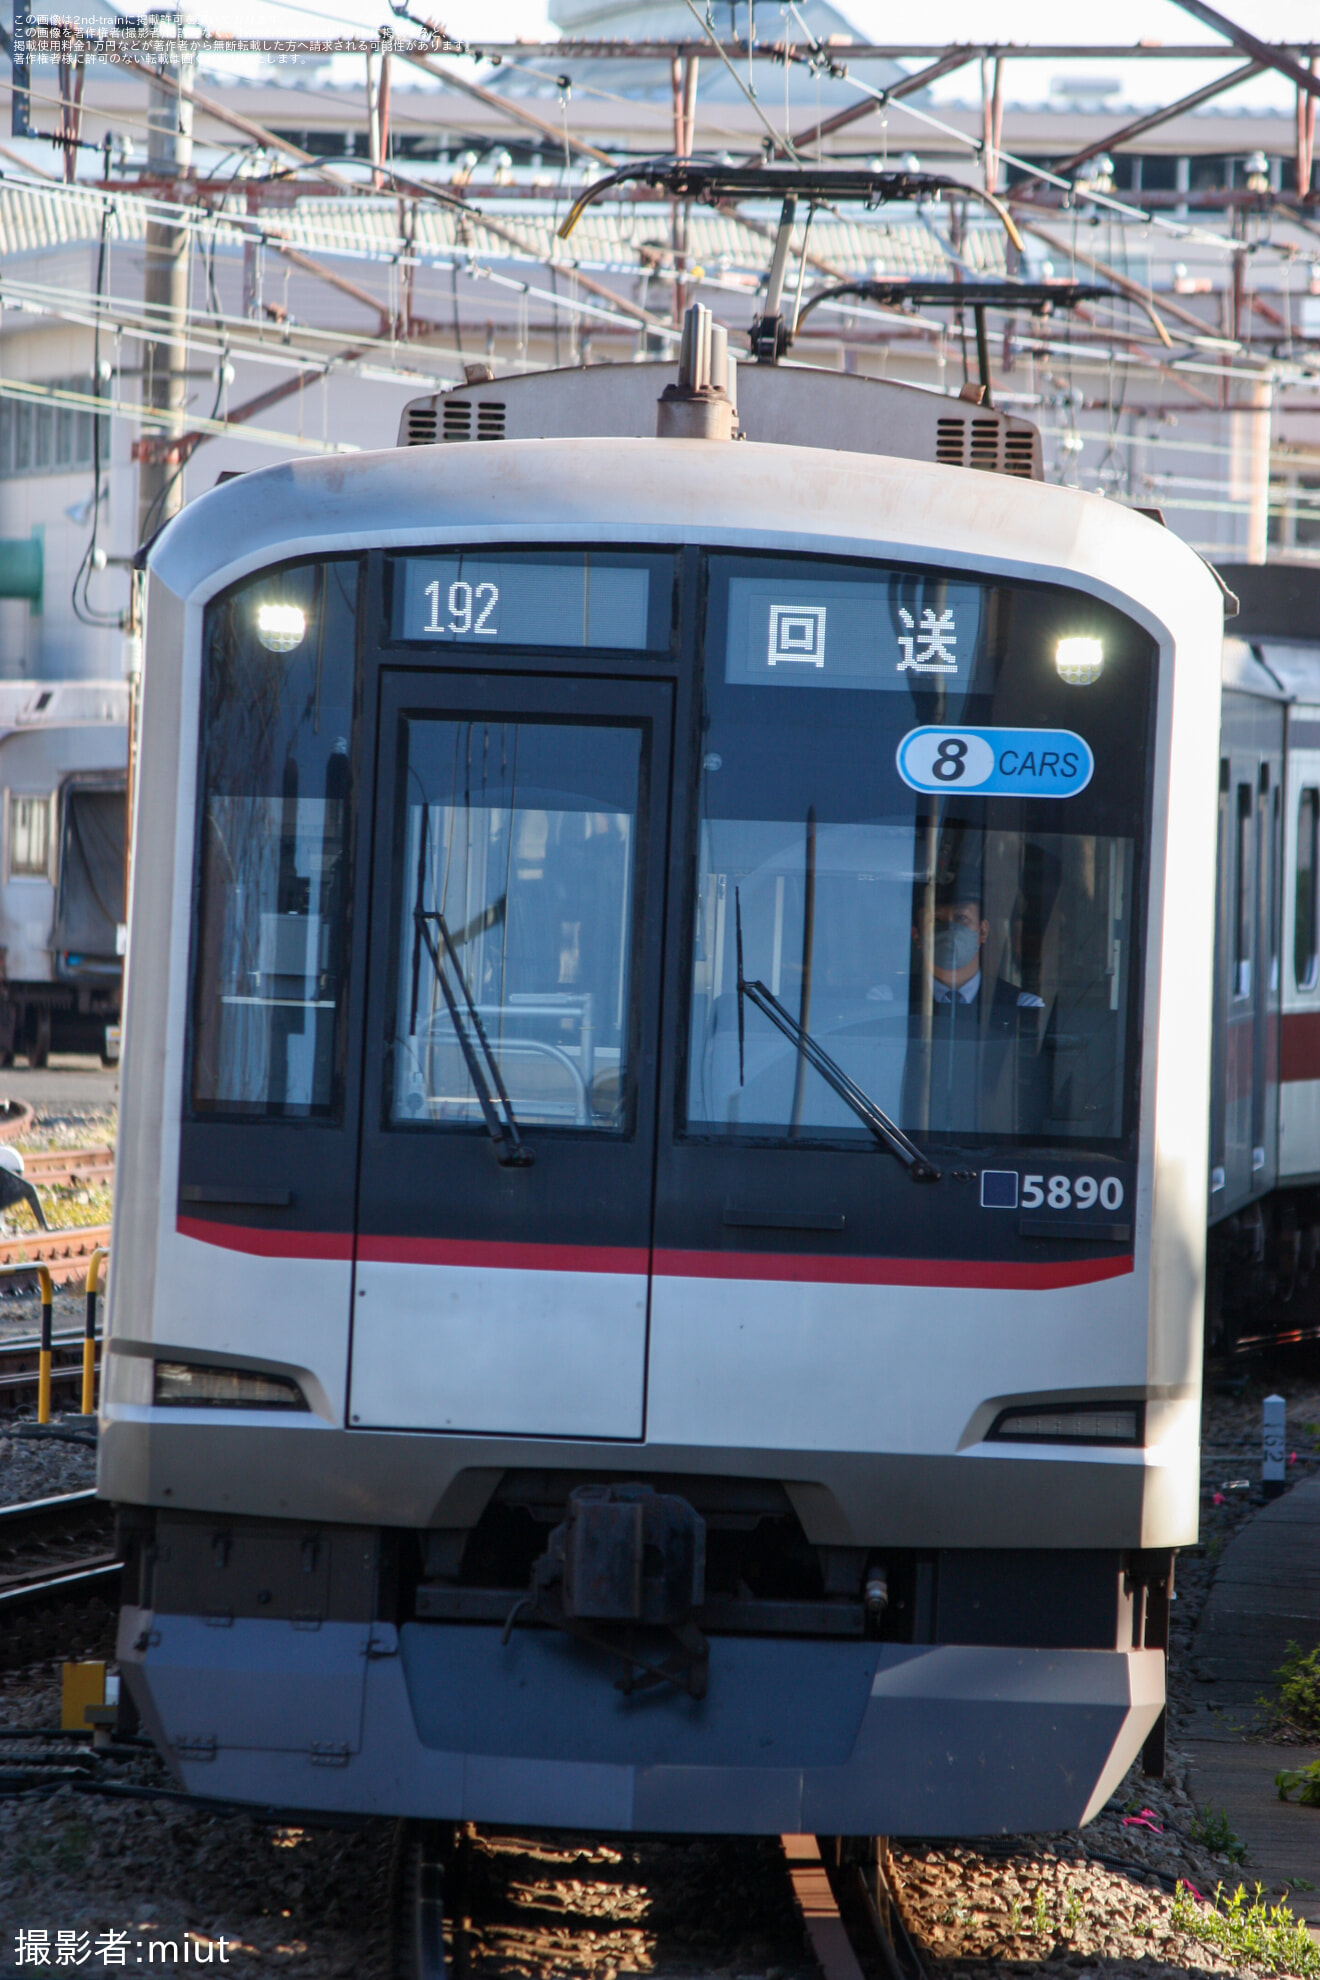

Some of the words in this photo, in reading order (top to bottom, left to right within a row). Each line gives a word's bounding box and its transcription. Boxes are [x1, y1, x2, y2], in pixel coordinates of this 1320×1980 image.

[422, 580, 500, 637] 192
[931, 738, 968, 782] 8
[998, 749, 1079, 779] CARS
[1021, 1174, 1125, 1211] 5890
